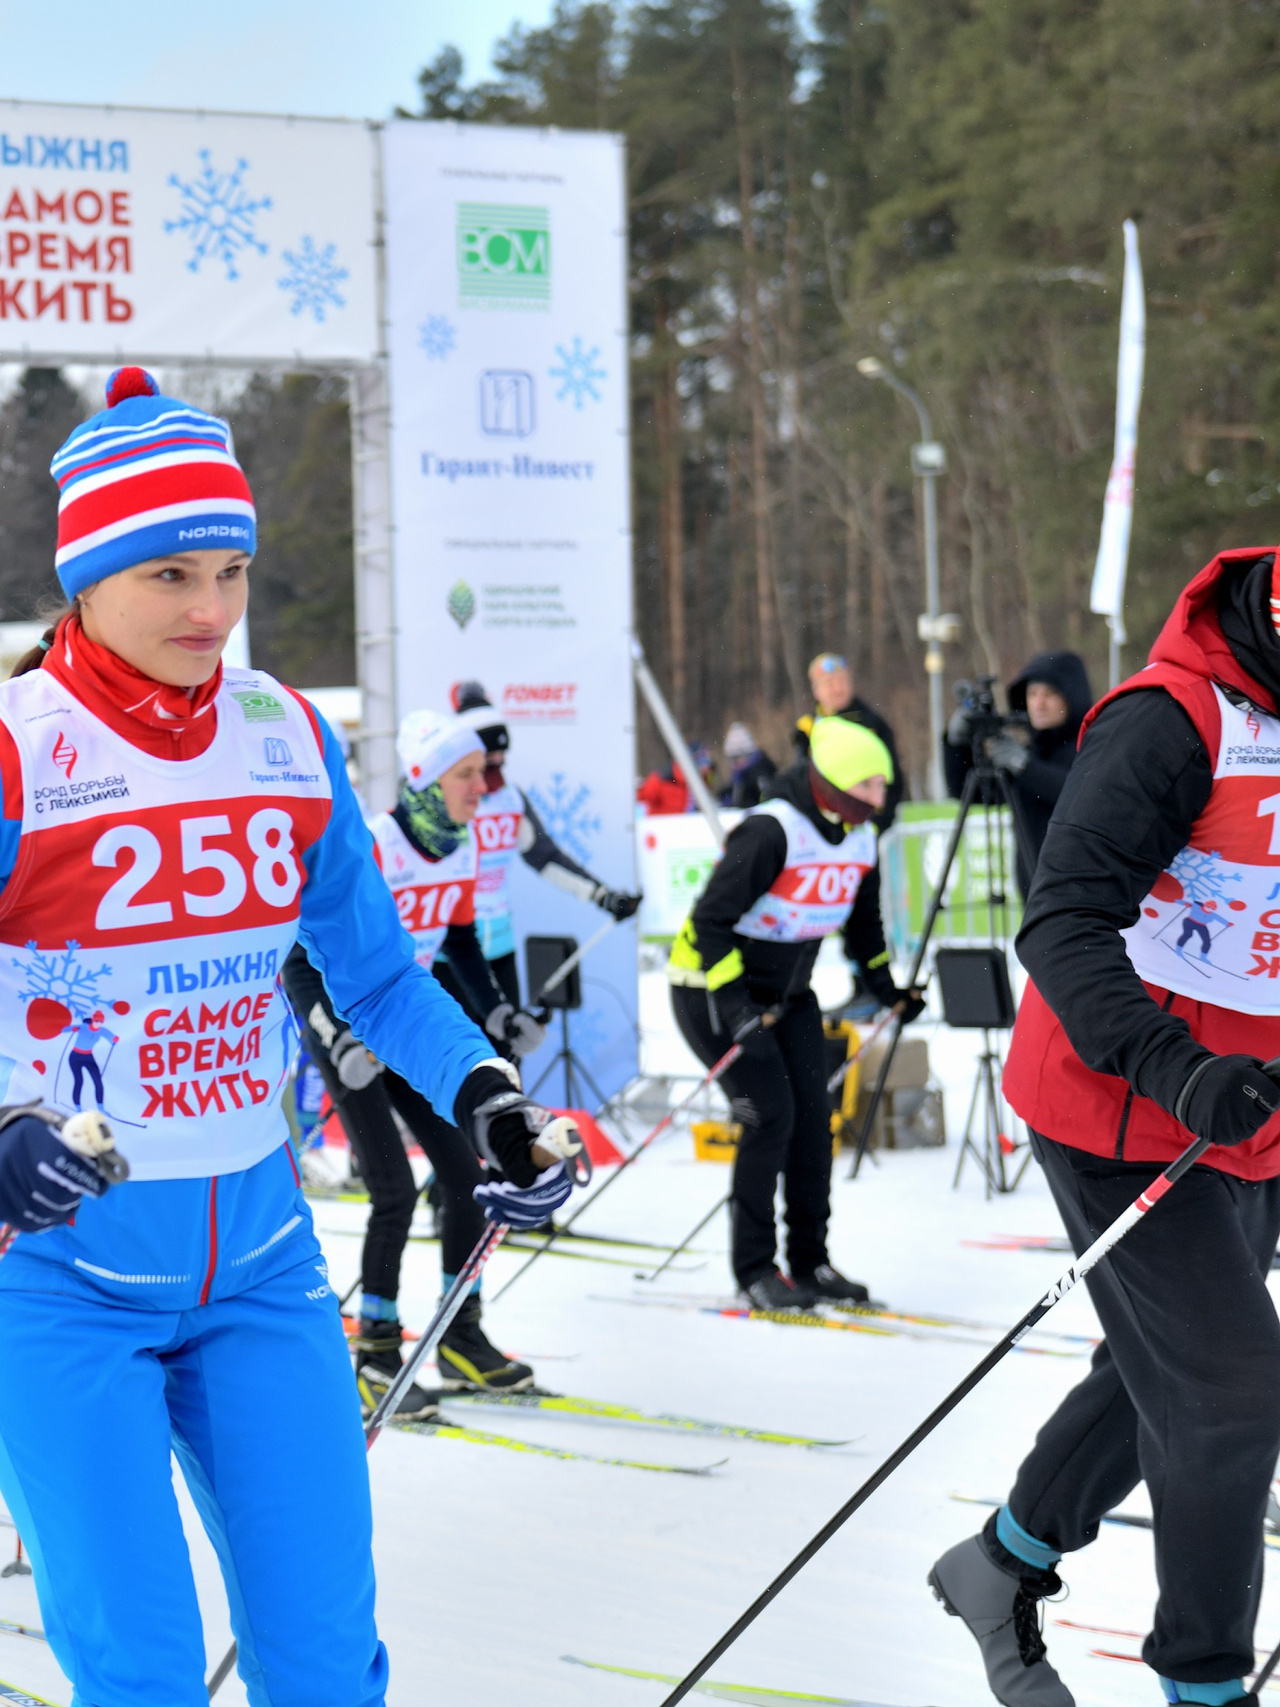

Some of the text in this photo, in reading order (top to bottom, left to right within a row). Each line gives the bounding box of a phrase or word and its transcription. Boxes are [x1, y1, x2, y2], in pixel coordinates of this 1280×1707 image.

[179, 525, 249, 541] NORDSKI
[35, 784, 130, 814] С ЛЕЙКЕМИЕЙ
[70, 774, 126, 795] БОРЬБЫ
[91, 807, 301, 931] 258
[790, 866, 862, 903] 709
[146, 948, 279, 996] ЛЫЖНЯ
[143, 992, 274, 1038] САМОЕ
[138, 1024, 262, 1079] ВРЕМЯ
[140, 1069, 270, 1119] ЖИТЬ
